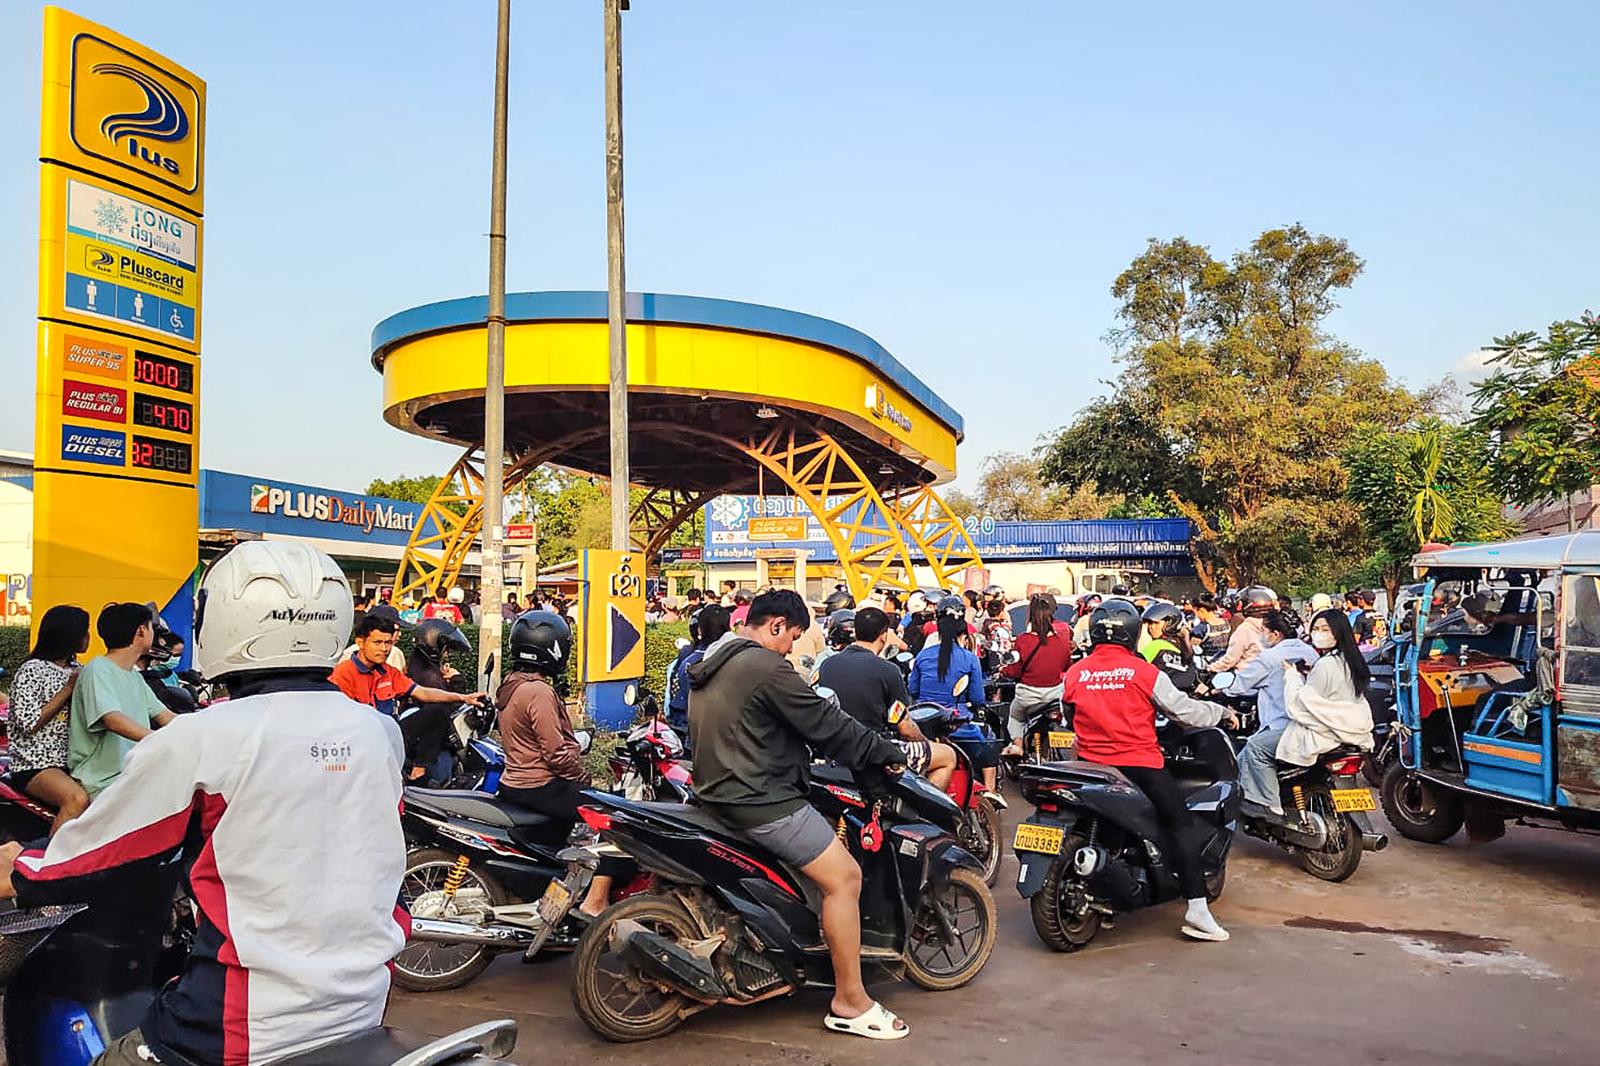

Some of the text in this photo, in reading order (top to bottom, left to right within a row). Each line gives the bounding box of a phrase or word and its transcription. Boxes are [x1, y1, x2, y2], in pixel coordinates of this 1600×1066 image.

[131, 205, 182, 239] TONG
[121, 256, 184, 289] Pluscard
[71, 345, 97, 357] PLUS
[68, 354, 105, 368] SUPER
[70, 390, 96, 402] PLUS
[67, 399, 112, 413] REGULAR
[153, 405, 189, 431] 470
[69, 434, 99, 446] PLUS
[65, 443, 124, 459] DIESEL
[310, 745, 351, 760] Sport
